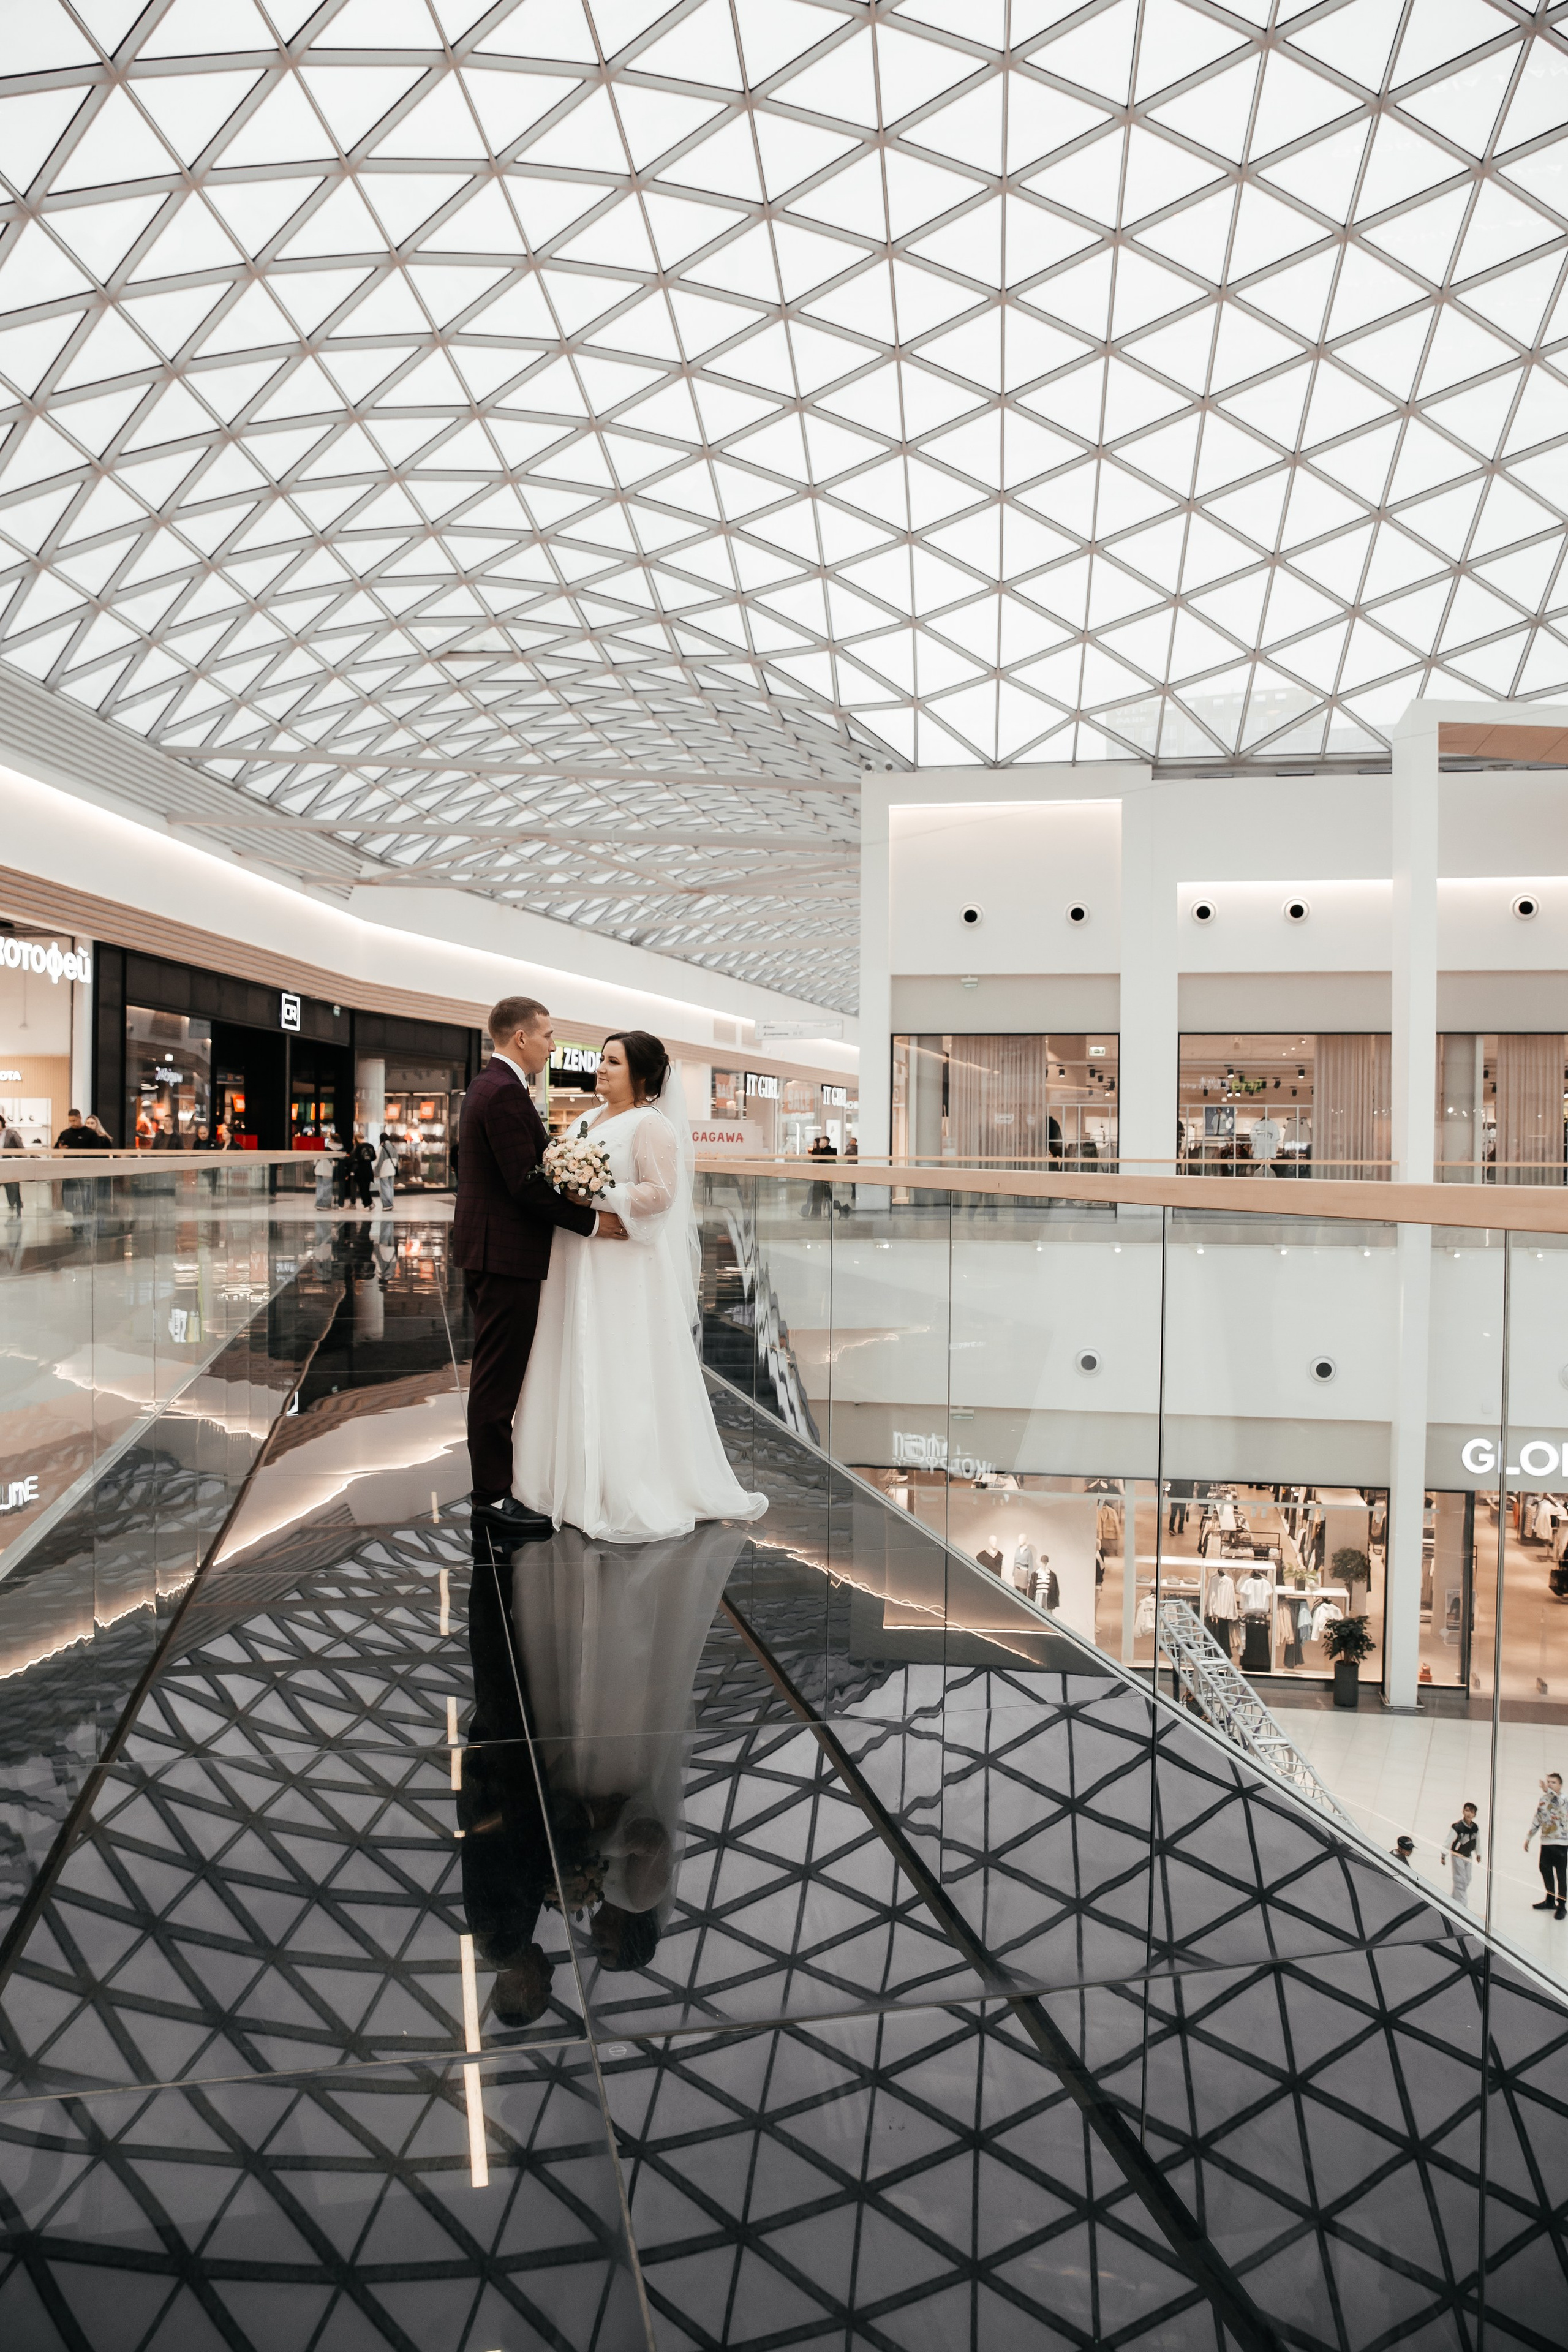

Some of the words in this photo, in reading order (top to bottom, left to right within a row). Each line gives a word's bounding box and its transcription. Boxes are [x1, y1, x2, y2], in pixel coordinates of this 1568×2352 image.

[746, 1074, 758, 1096] IT
[758, 1076, 779, 1099] GIRL
[823, 1085, 832, 1105] IT
[692, 1131, 744, 1143] GAGAWA
[1461, 1438, 1568, 1477] GLO
